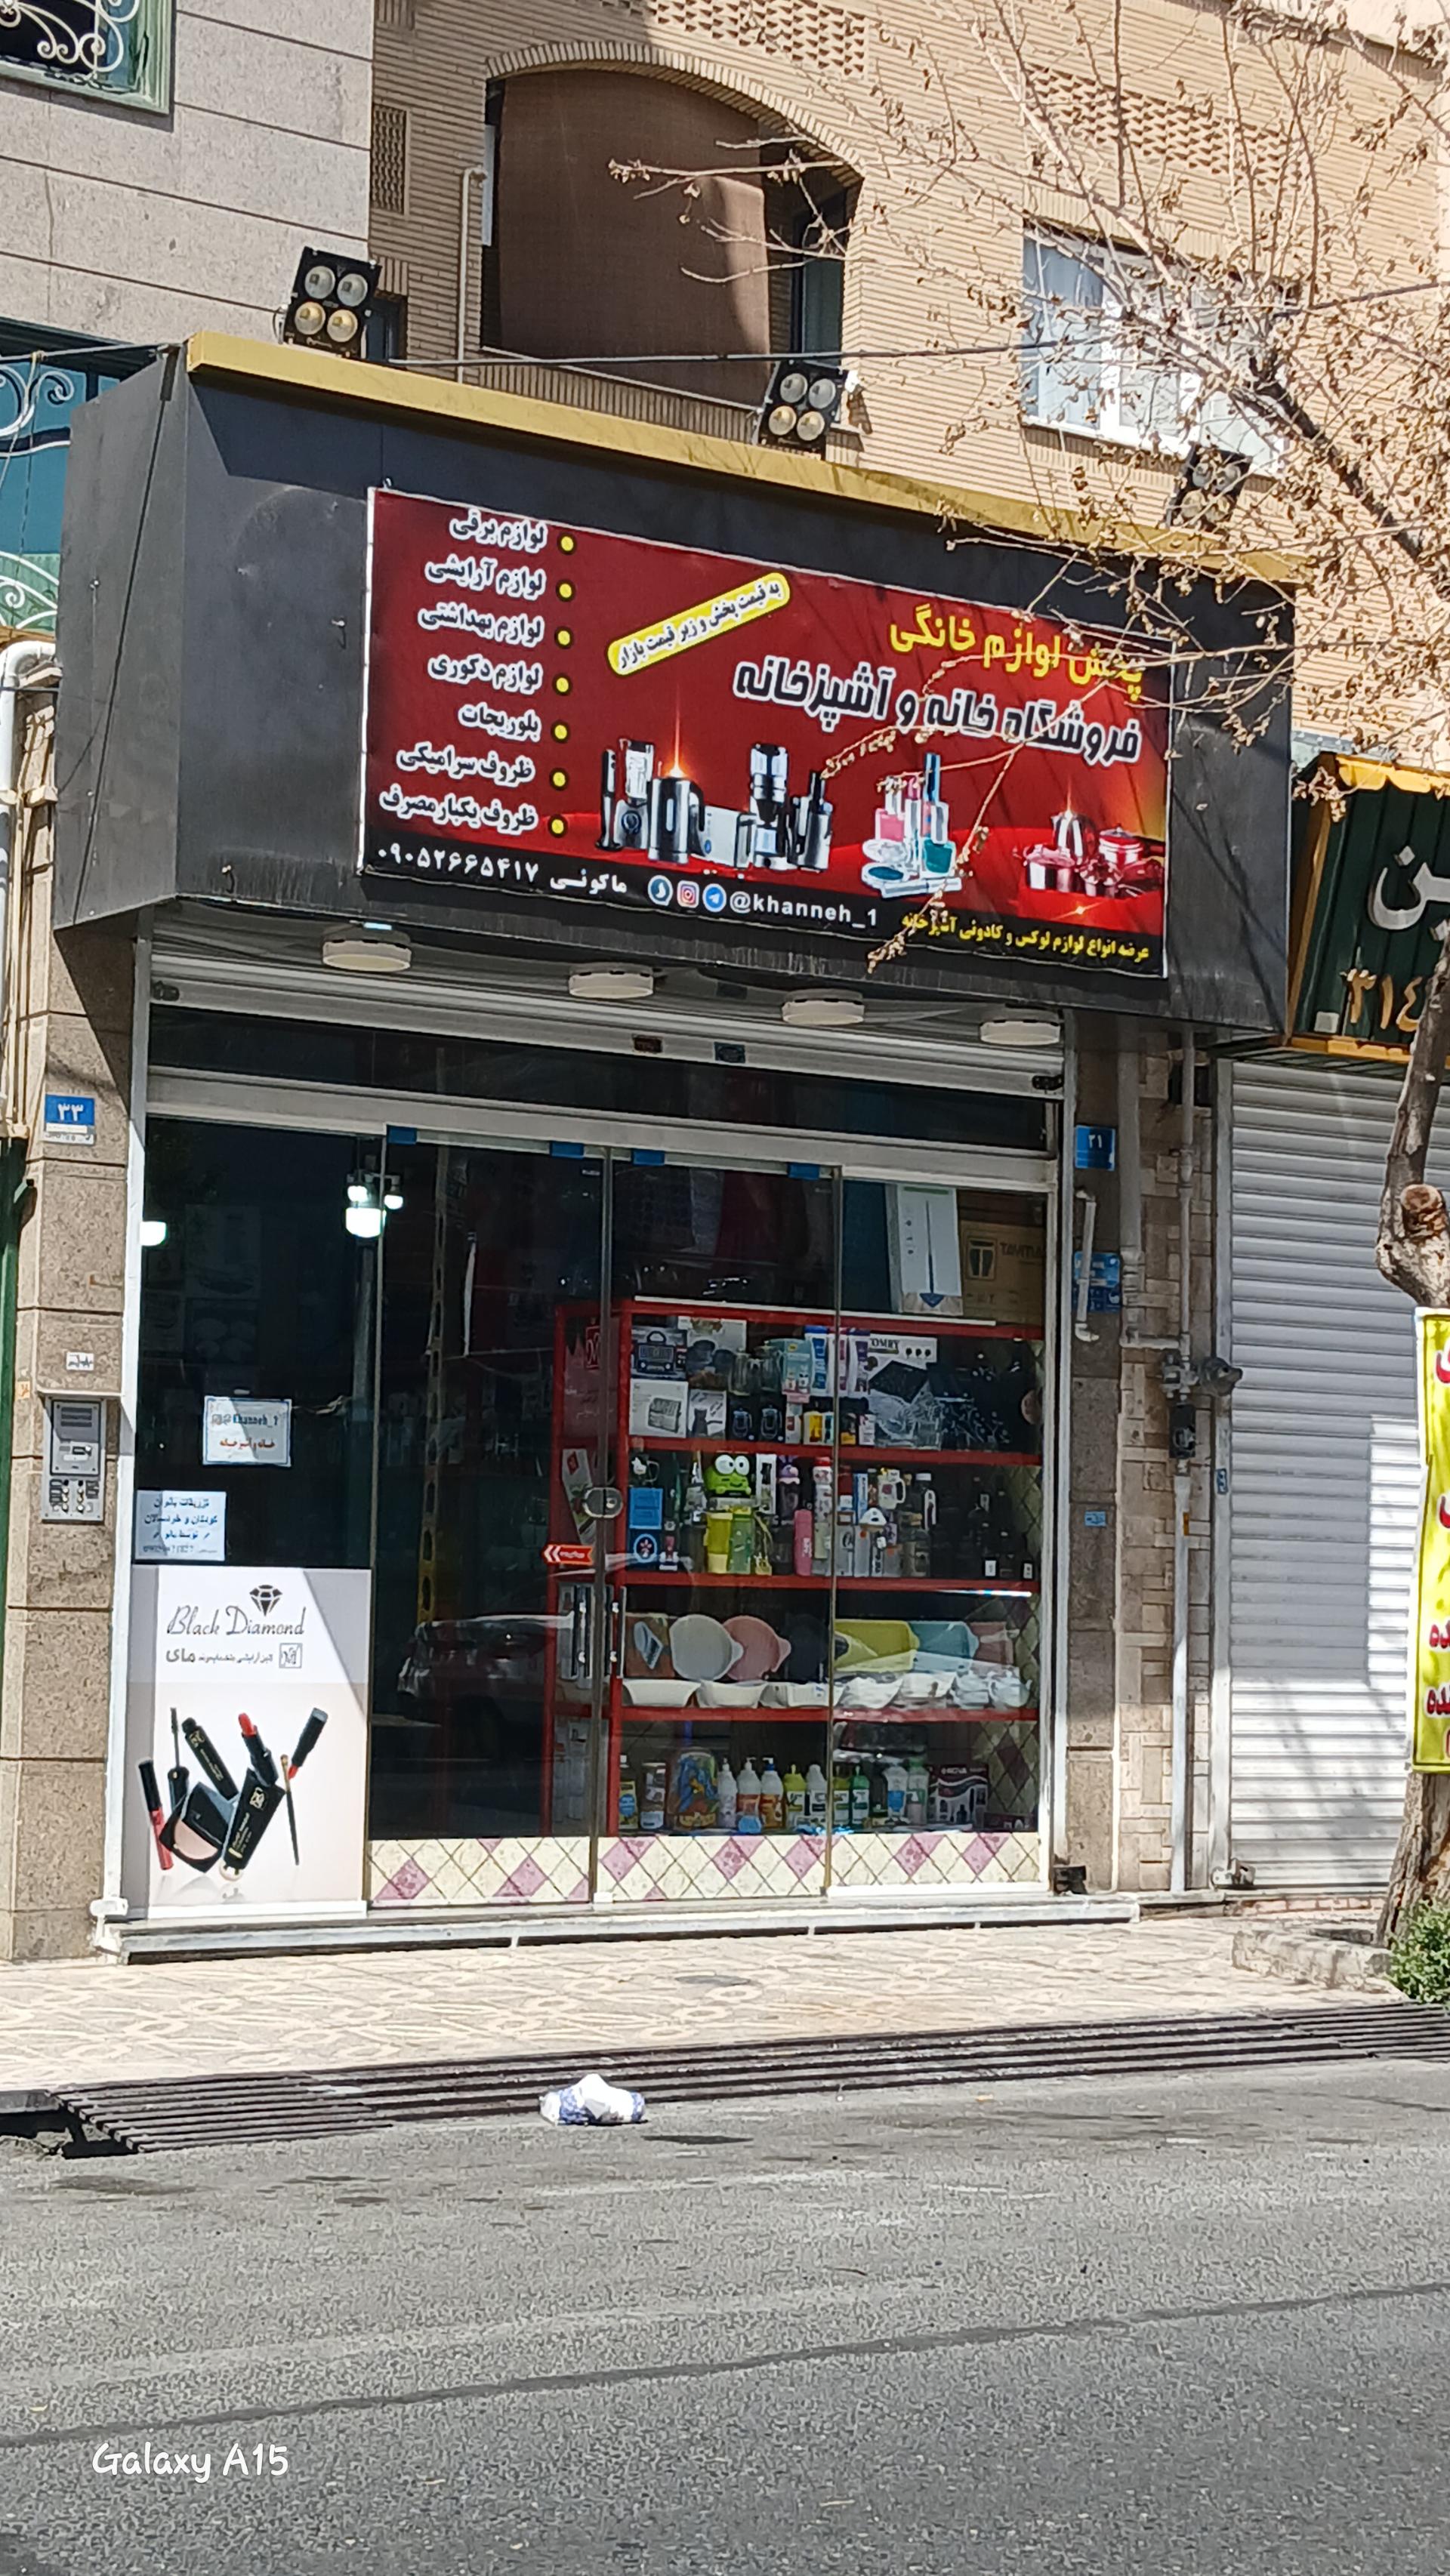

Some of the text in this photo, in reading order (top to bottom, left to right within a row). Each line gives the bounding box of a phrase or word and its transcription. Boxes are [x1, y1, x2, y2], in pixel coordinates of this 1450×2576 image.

[452, 510, 546, 550] لوازم برقی
[426, 556, 545, 597] لوازم آرایشی
[769, 583, 781, 598] به
[738, 584, 767, 605] قیمت
[420, 603, 543, 645] لوازم بهداشتی
[646, 625, 675, 648] قیمت
[680, 620, 698, 642] زیر
[699, 619, 707, 633] و
[890, 603, 976, 652] خانگی
[619, 641, 644, 669] بازار
[983, 627, 1061, 678] لوازم
[429, 656, 541, 692] لوازم دکوری
[459, 704, 541, 740] بلوریجات
[735, 656, 1141, 766] فروشگاه خانه و آشپزخانه
[398, 744, 535, 784] ظروف سرامیکی
[482, 801, 537, 832] ظروف
[550, 867, 628, 895] ماکونی
[729, 891, 878, 929] @khanneh_1
[1004, 932, 1013, 946] و
[1016, 930, 1050, 950] لوکس
[1052, 934, 1084, 955] لوازم
[1086, 938, 1116, 958] انواع
[1118, 941, 1149, 963] عرضه
[57, 1103, 84, 1122] ۳۳
[1088, 1135, 1103, 1148] ۲۱
[166, 1604, 307, 1635] Black Diamond
